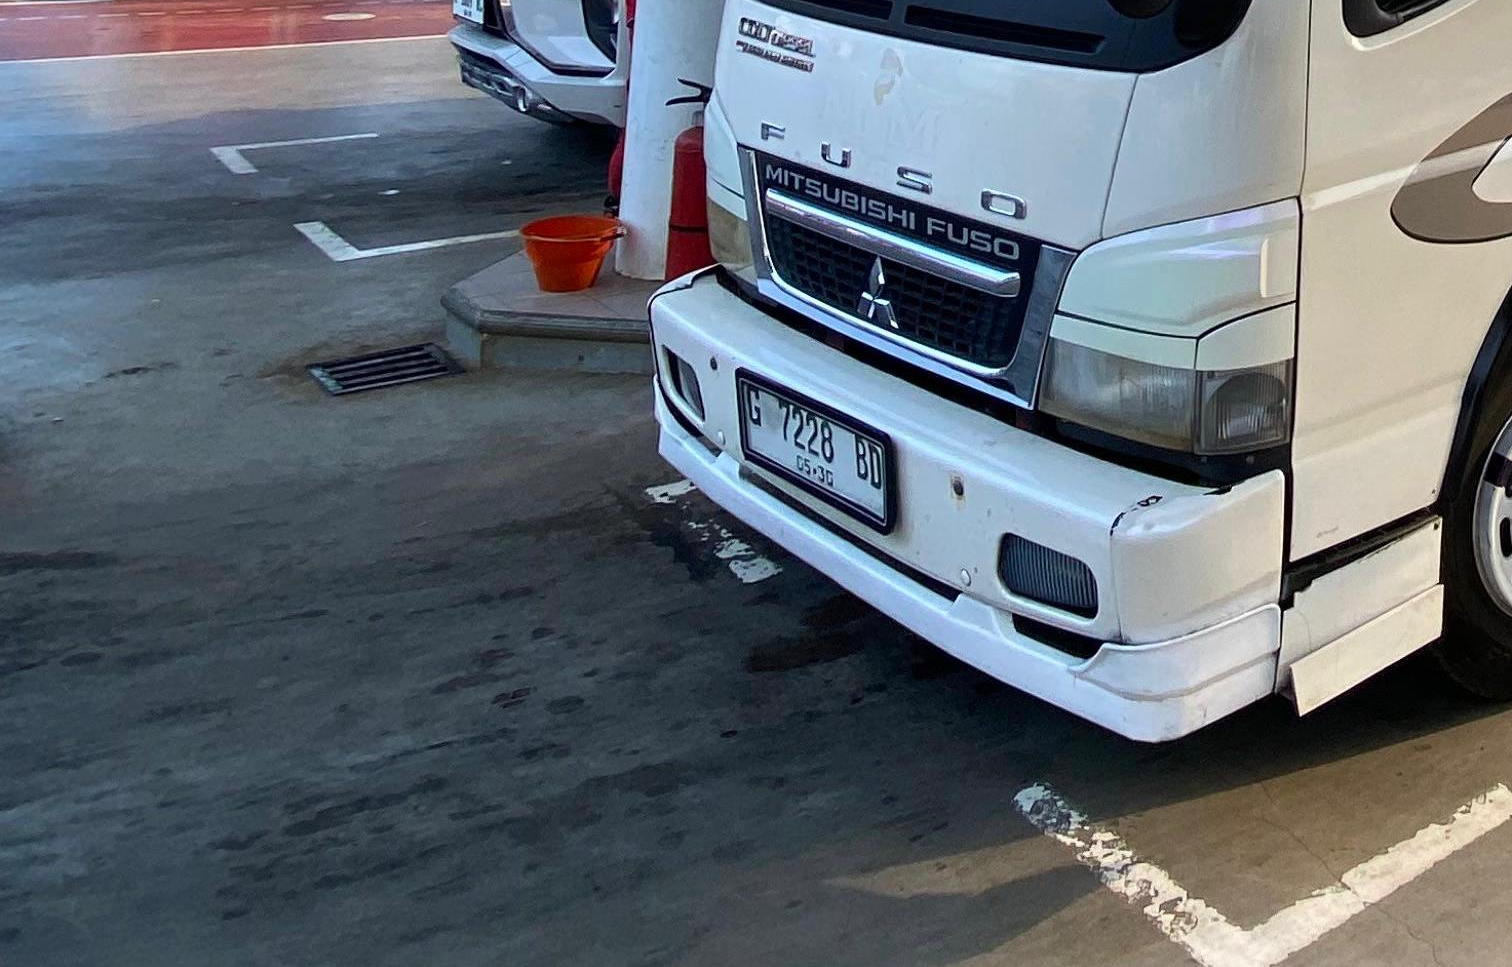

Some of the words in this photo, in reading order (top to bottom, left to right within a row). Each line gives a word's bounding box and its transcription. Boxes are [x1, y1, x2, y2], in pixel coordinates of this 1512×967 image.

[761, 121, 1027, 220] FUSO
[765, 164, 916, 230] MITSUBISHI
[926, 216, 1020, 261] FUSO
[749, 387, 762, 427] G
[778, 398, 834, 464] 7228
[854, 433, 882, 490] BD
